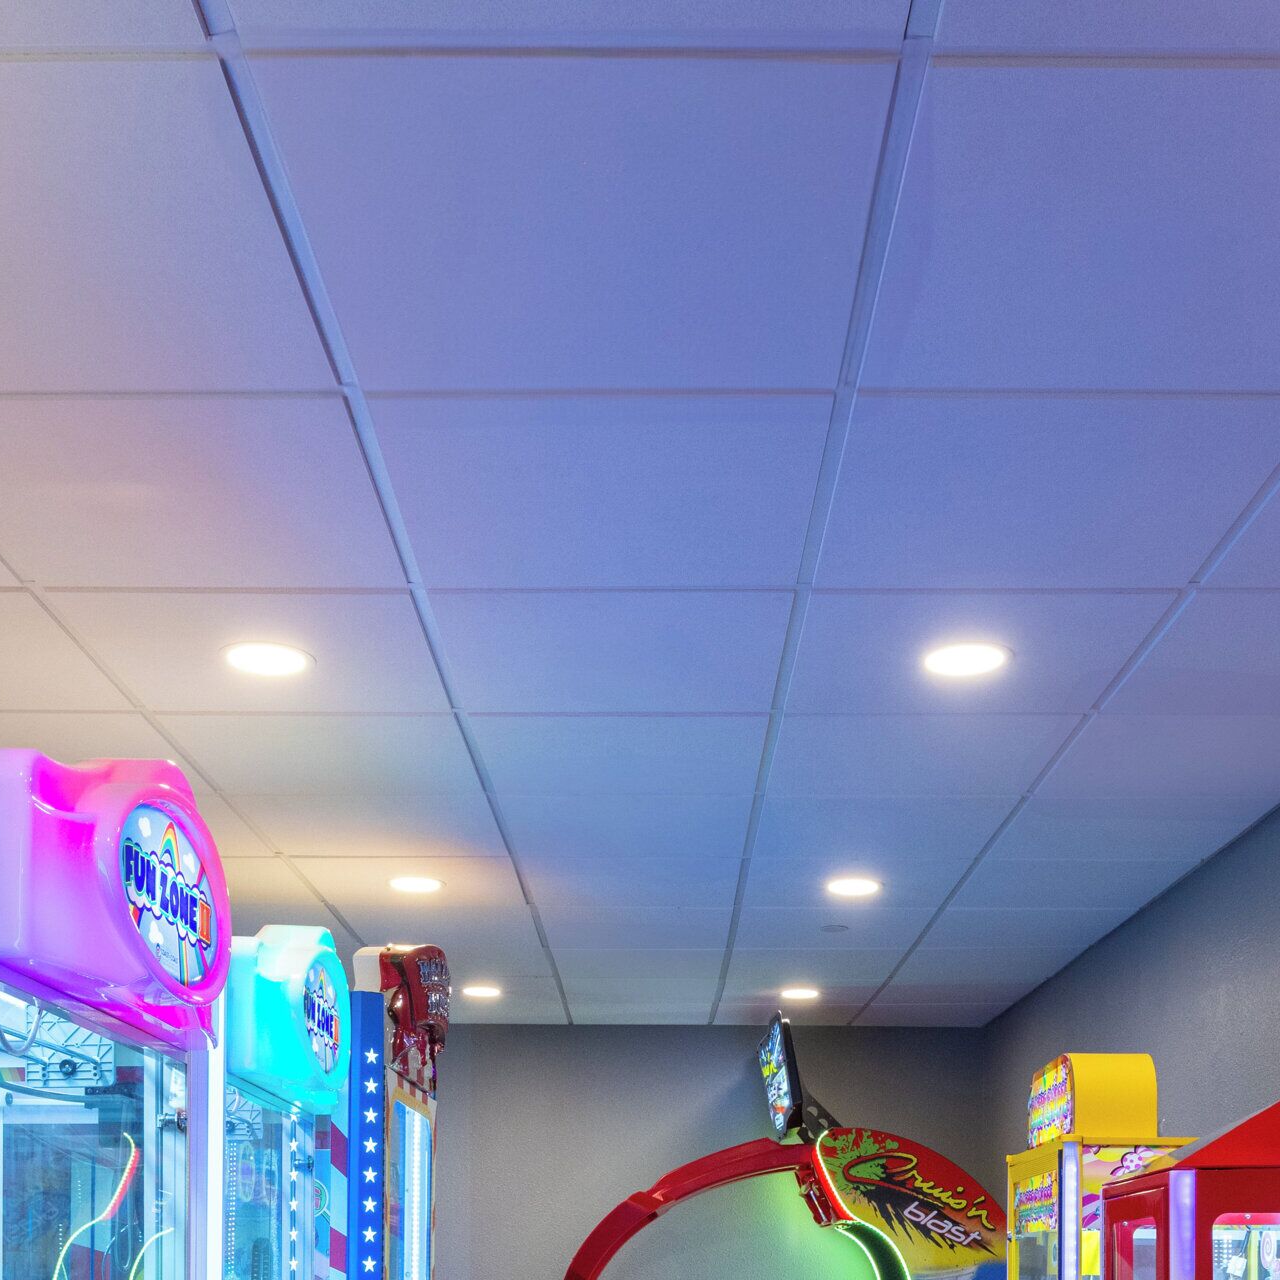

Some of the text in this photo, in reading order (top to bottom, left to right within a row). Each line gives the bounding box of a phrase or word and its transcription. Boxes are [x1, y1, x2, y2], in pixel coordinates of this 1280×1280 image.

[123, 842, 157, 906] FUN
[159, 864, 200, 939] ZONE
[842, 1151, 996, 1232] Cruis'n
[903, 1201, 982, 1246] blast
